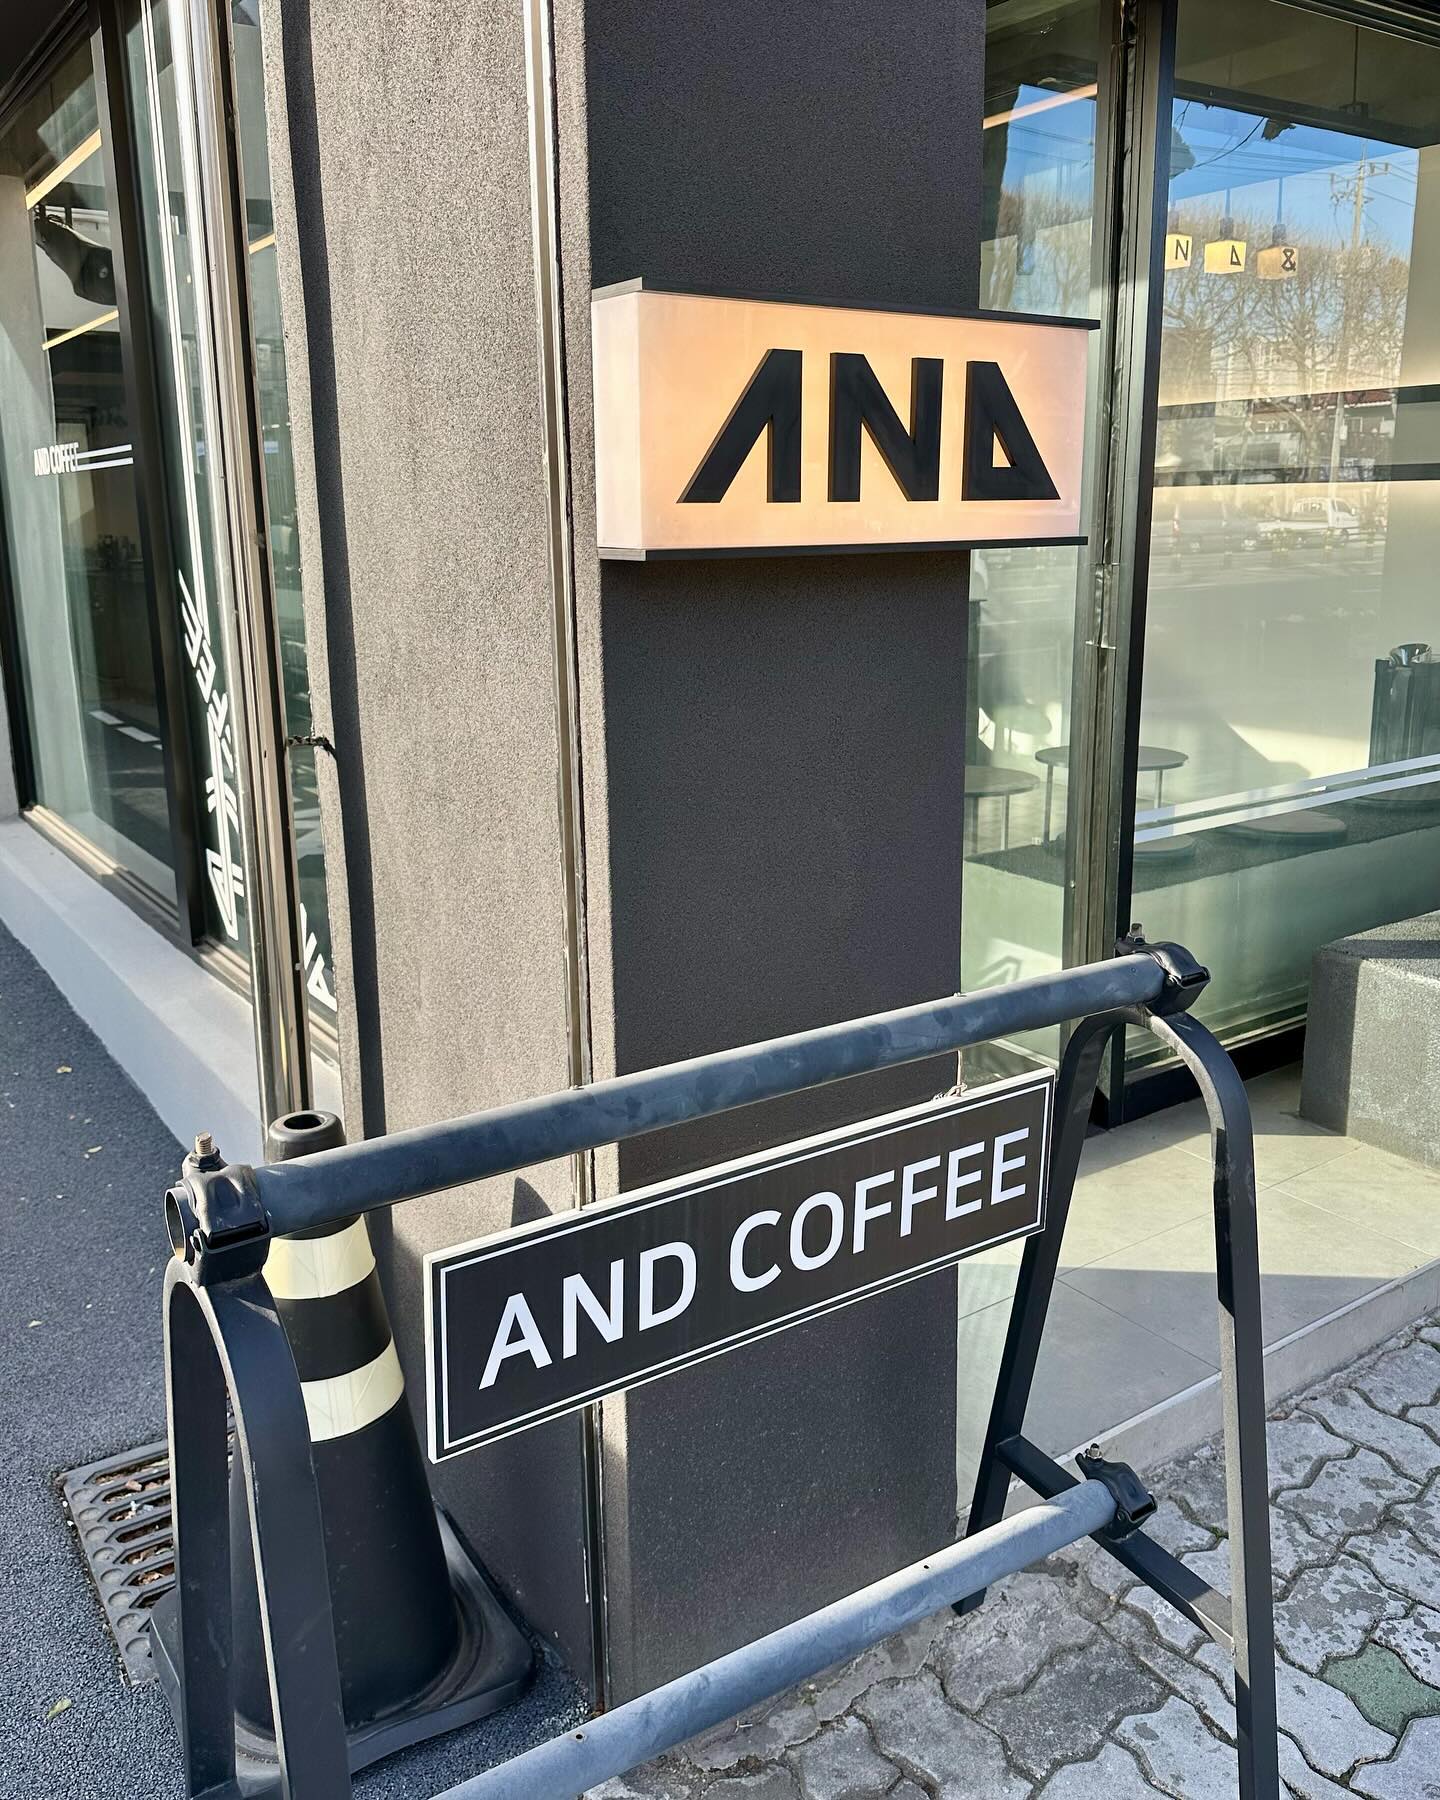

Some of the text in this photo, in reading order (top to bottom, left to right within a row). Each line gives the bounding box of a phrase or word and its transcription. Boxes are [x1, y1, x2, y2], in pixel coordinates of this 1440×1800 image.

[1174, 239, 1190, 261] N
[1281, 248, 1297, 272] &
[34, 442, 79, 476] AND COFFEE
[478, 1126, 1031, 1391] AND COFFEE
